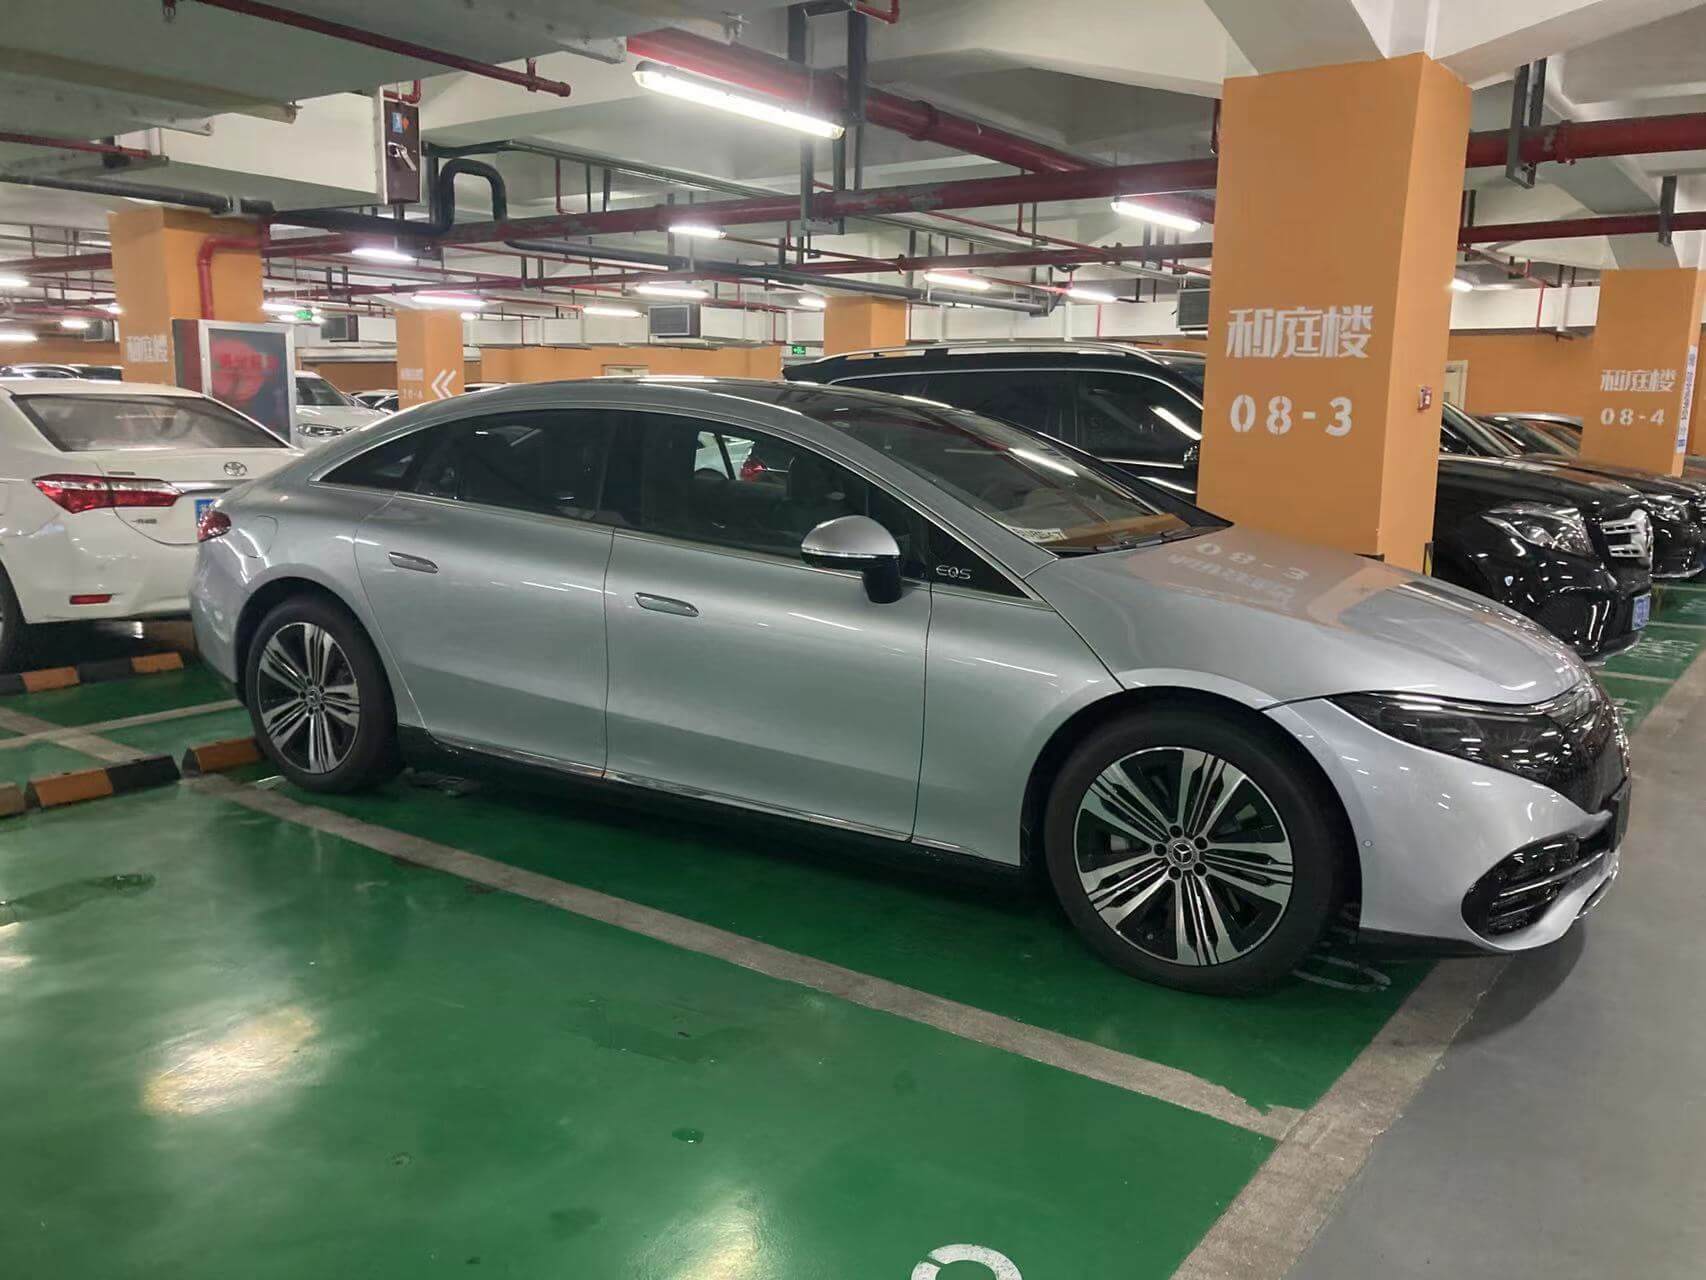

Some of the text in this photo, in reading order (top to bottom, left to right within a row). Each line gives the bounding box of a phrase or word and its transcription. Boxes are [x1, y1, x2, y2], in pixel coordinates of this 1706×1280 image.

[1226, 304, 1373, 358] 和庭楼
[1230, 394, 1353, 437] 08-3
[1600, 407, 1665, 427] 08-4
[936, 564, 972, 580] EQS
